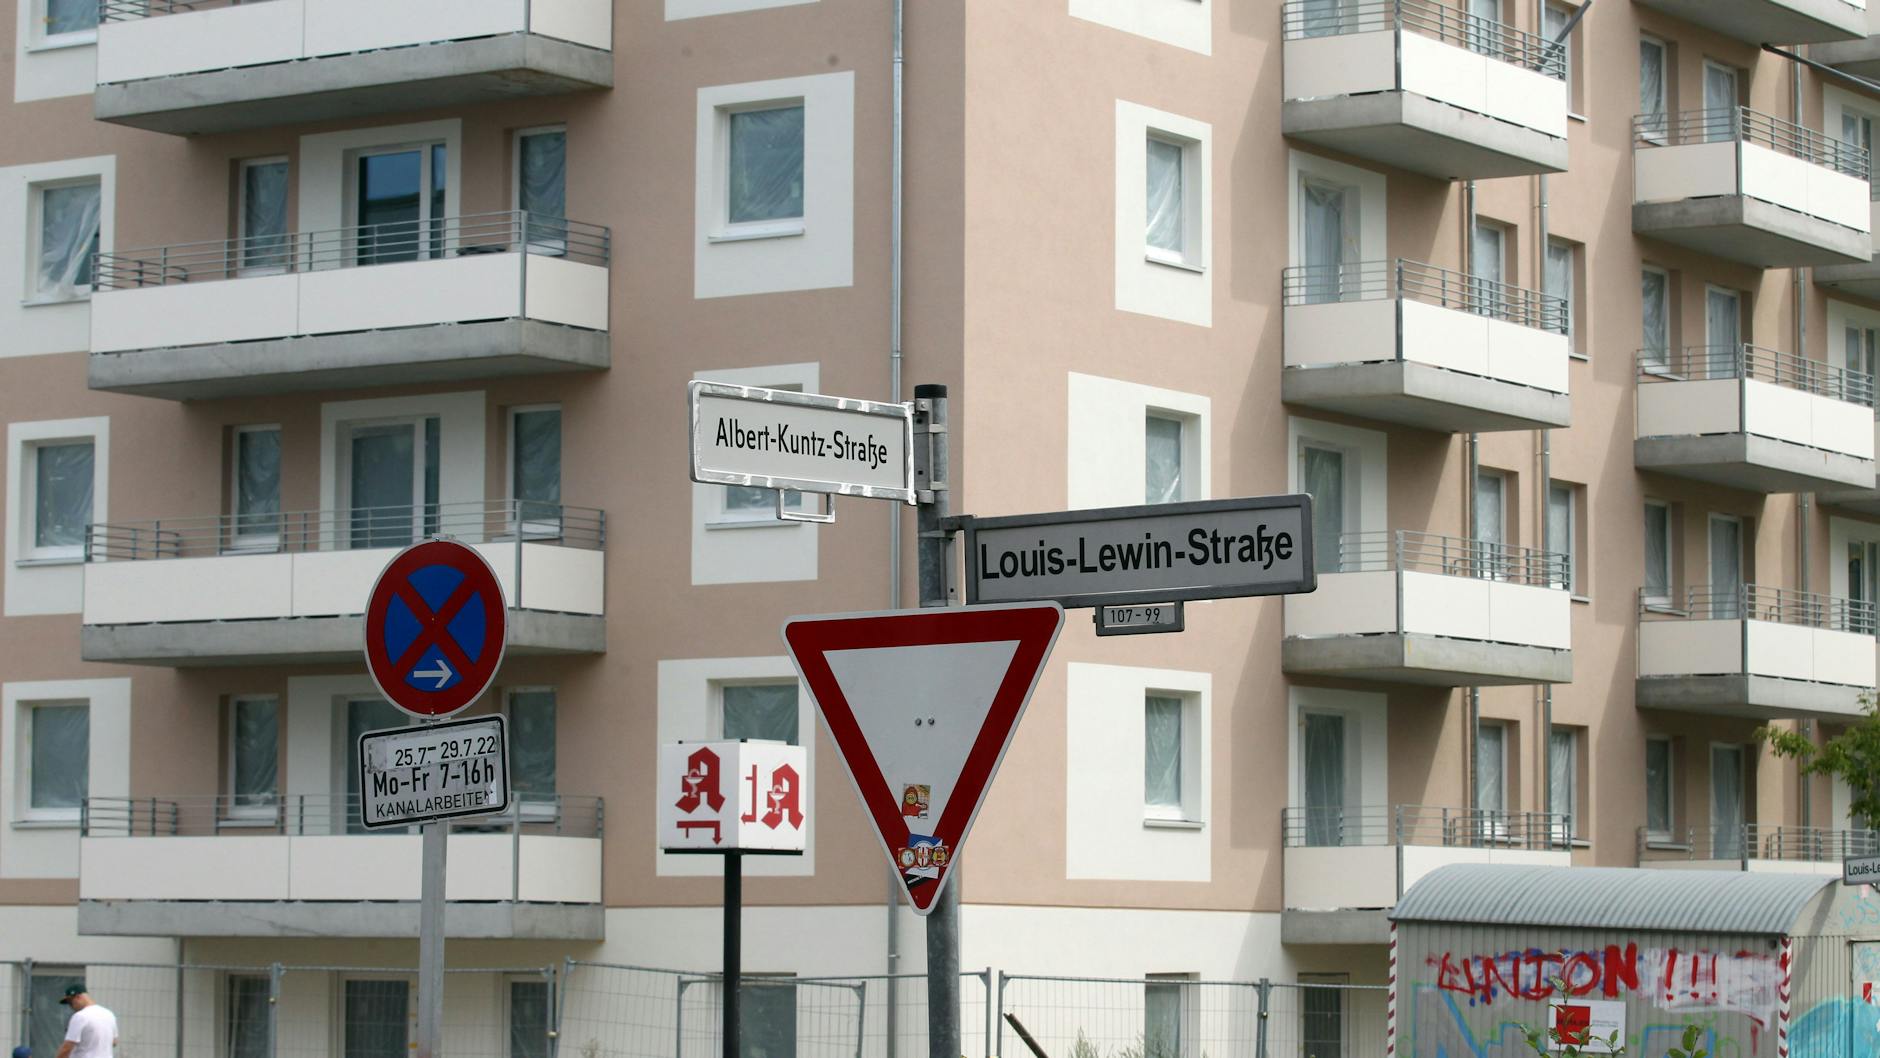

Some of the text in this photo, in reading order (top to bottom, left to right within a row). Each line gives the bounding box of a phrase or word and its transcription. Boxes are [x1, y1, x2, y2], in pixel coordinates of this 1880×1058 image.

[716, 418, 887, 469] Albert-Kuntz-Straße
[981, 525, 1293, 580] Louis-Lewin-Straße
[373, 767, 430, 797] Mo-Fr
